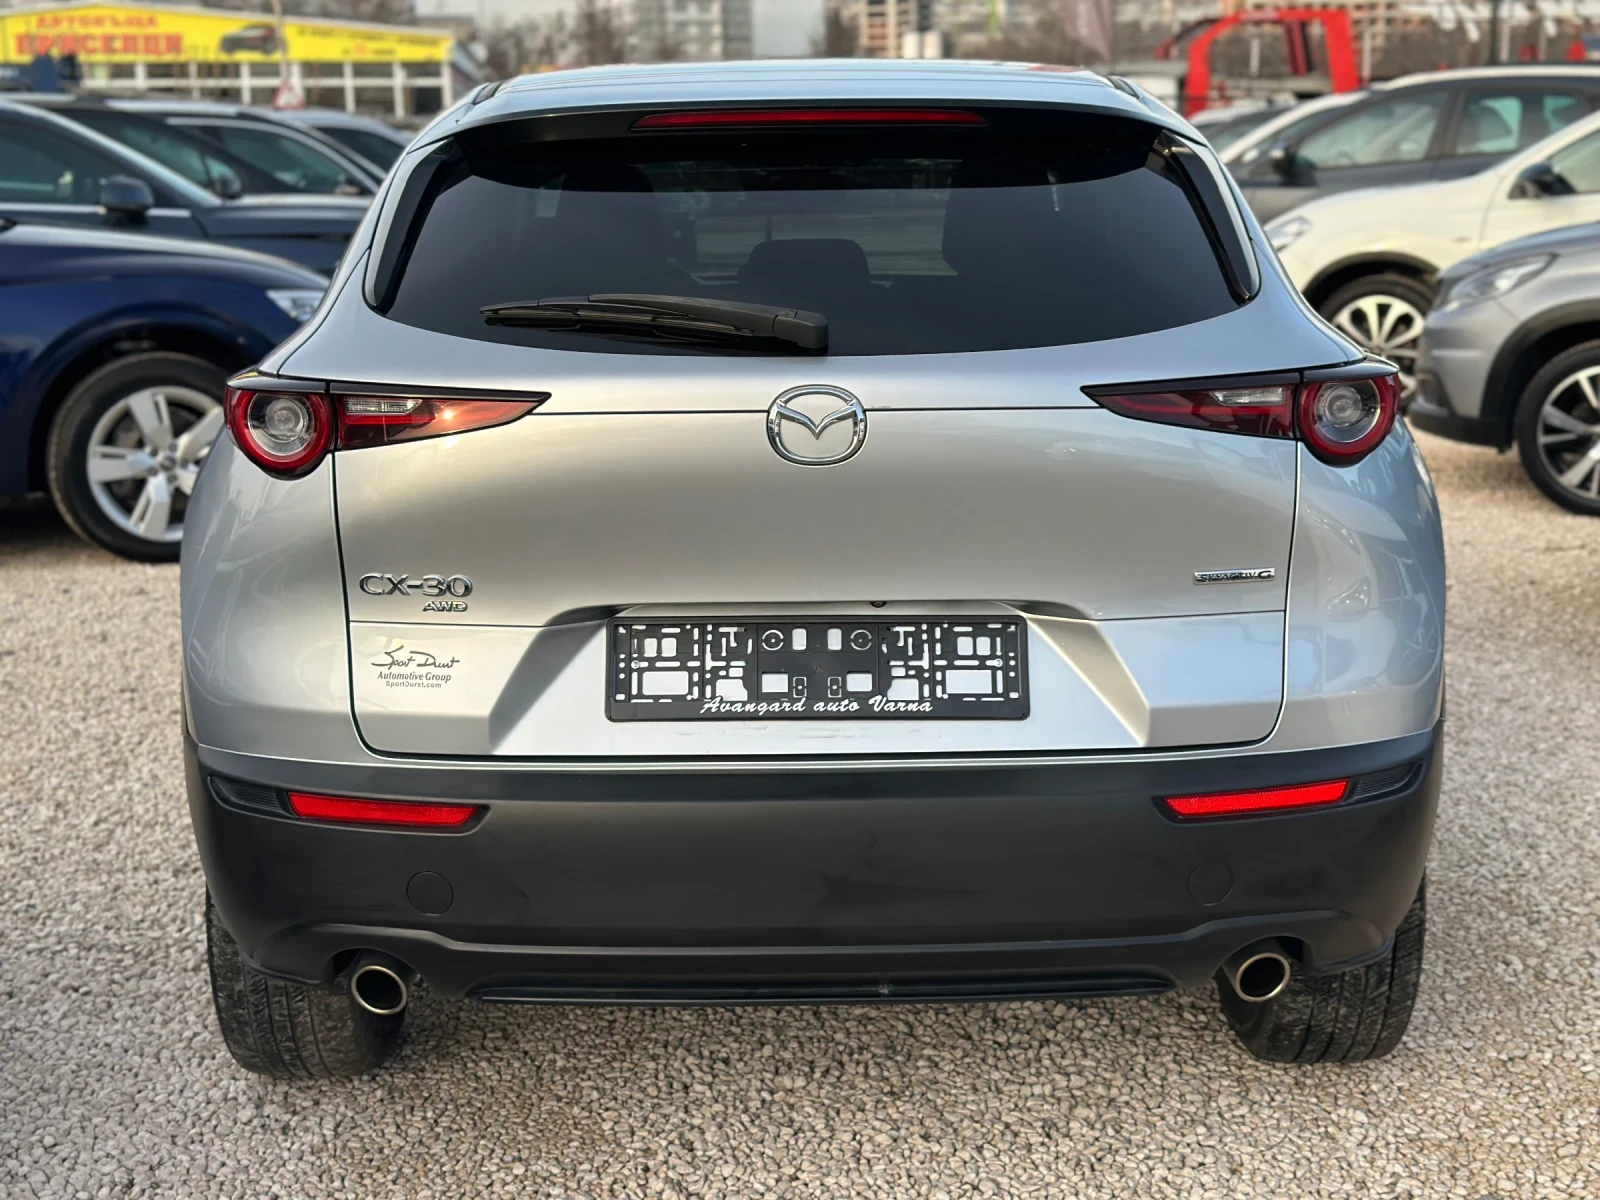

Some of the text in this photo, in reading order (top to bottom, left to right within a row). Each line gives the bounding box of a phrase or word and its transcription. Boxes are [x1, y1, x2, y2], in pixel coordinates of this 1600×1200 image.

[359, 572, 473, 598] CX-30
[422, 600, 468, 612] AWD
[377, 671, 452, 684] Automotive Group
[385, 680, 442, 689] SportDurst.com
[700, 695, 933, 716] Avangard auto Varna
